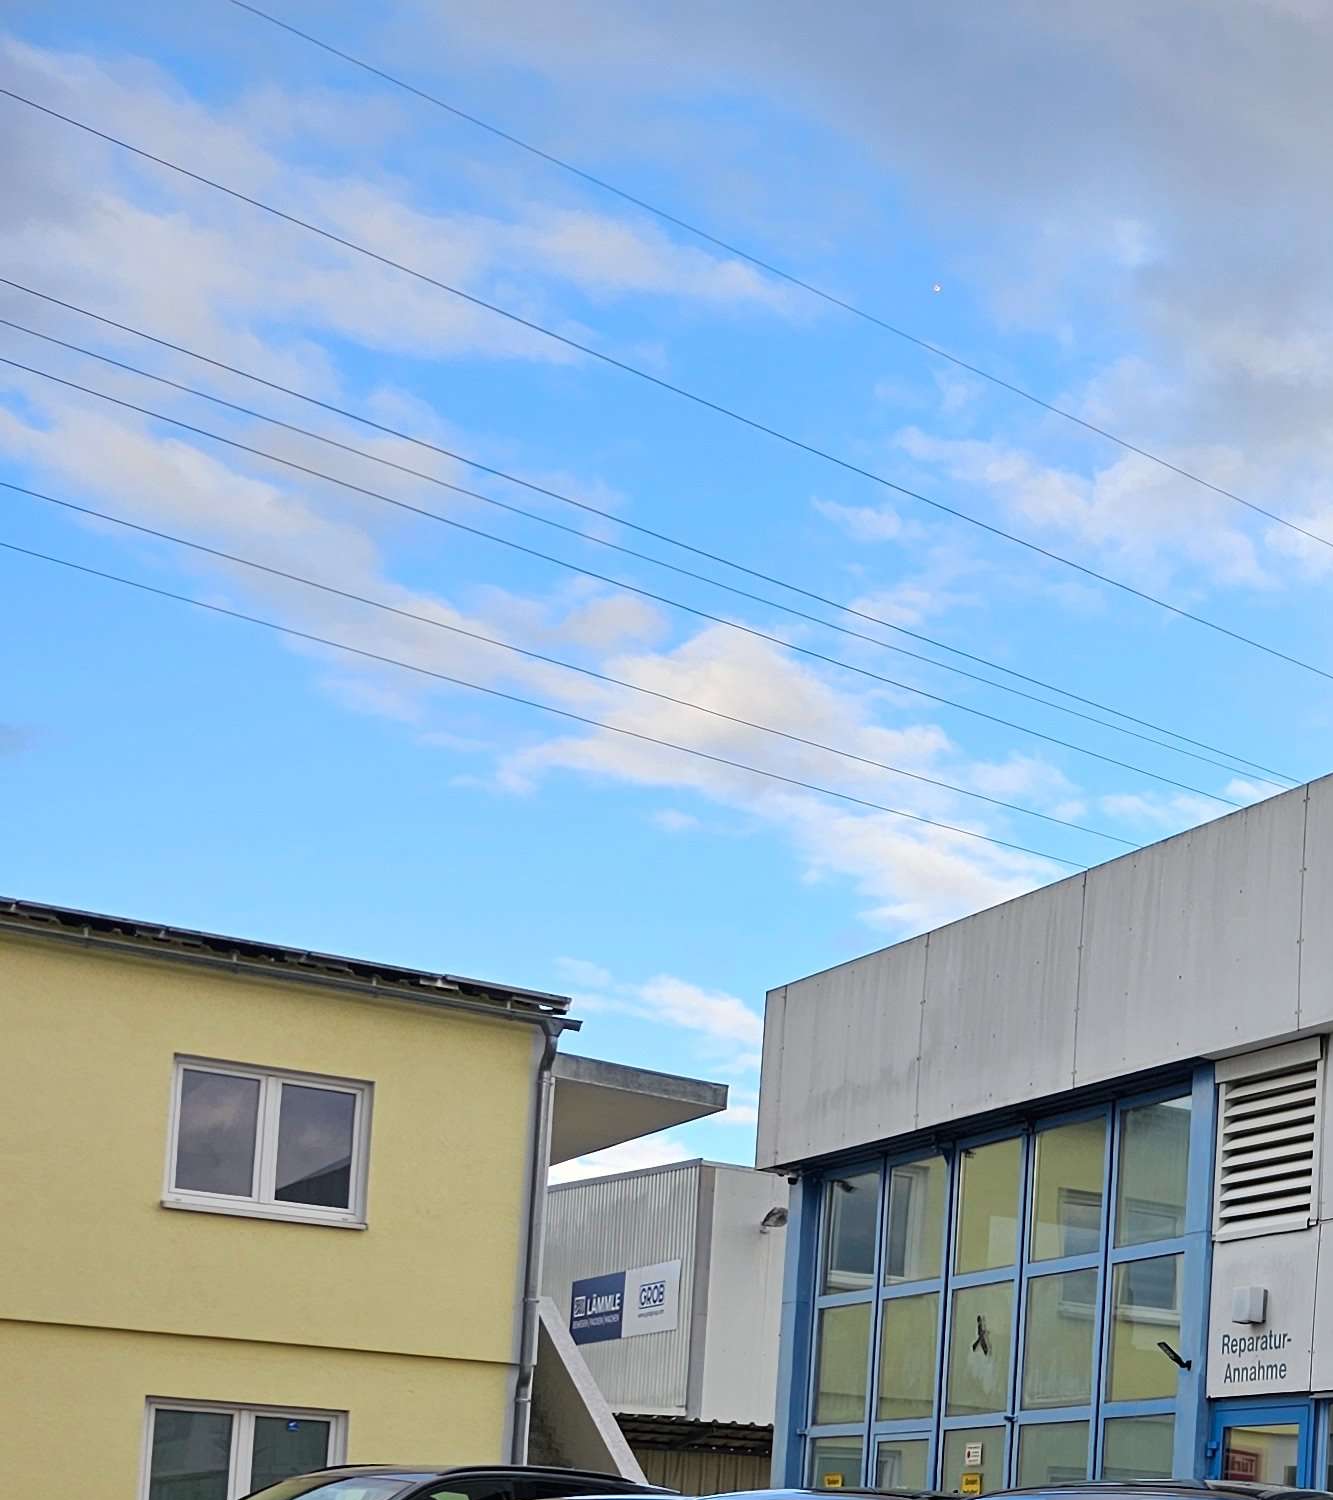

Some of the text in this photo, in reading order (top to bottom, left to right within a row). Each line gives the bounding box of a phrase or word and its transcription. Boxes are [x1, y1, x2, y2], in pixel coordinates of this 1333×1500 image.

[640, 1284, 665, 1306] GROB
[1221, 1329, 1292, 1358] Reparatur-
[1223, 1360, 1287, 1384] Annahme
